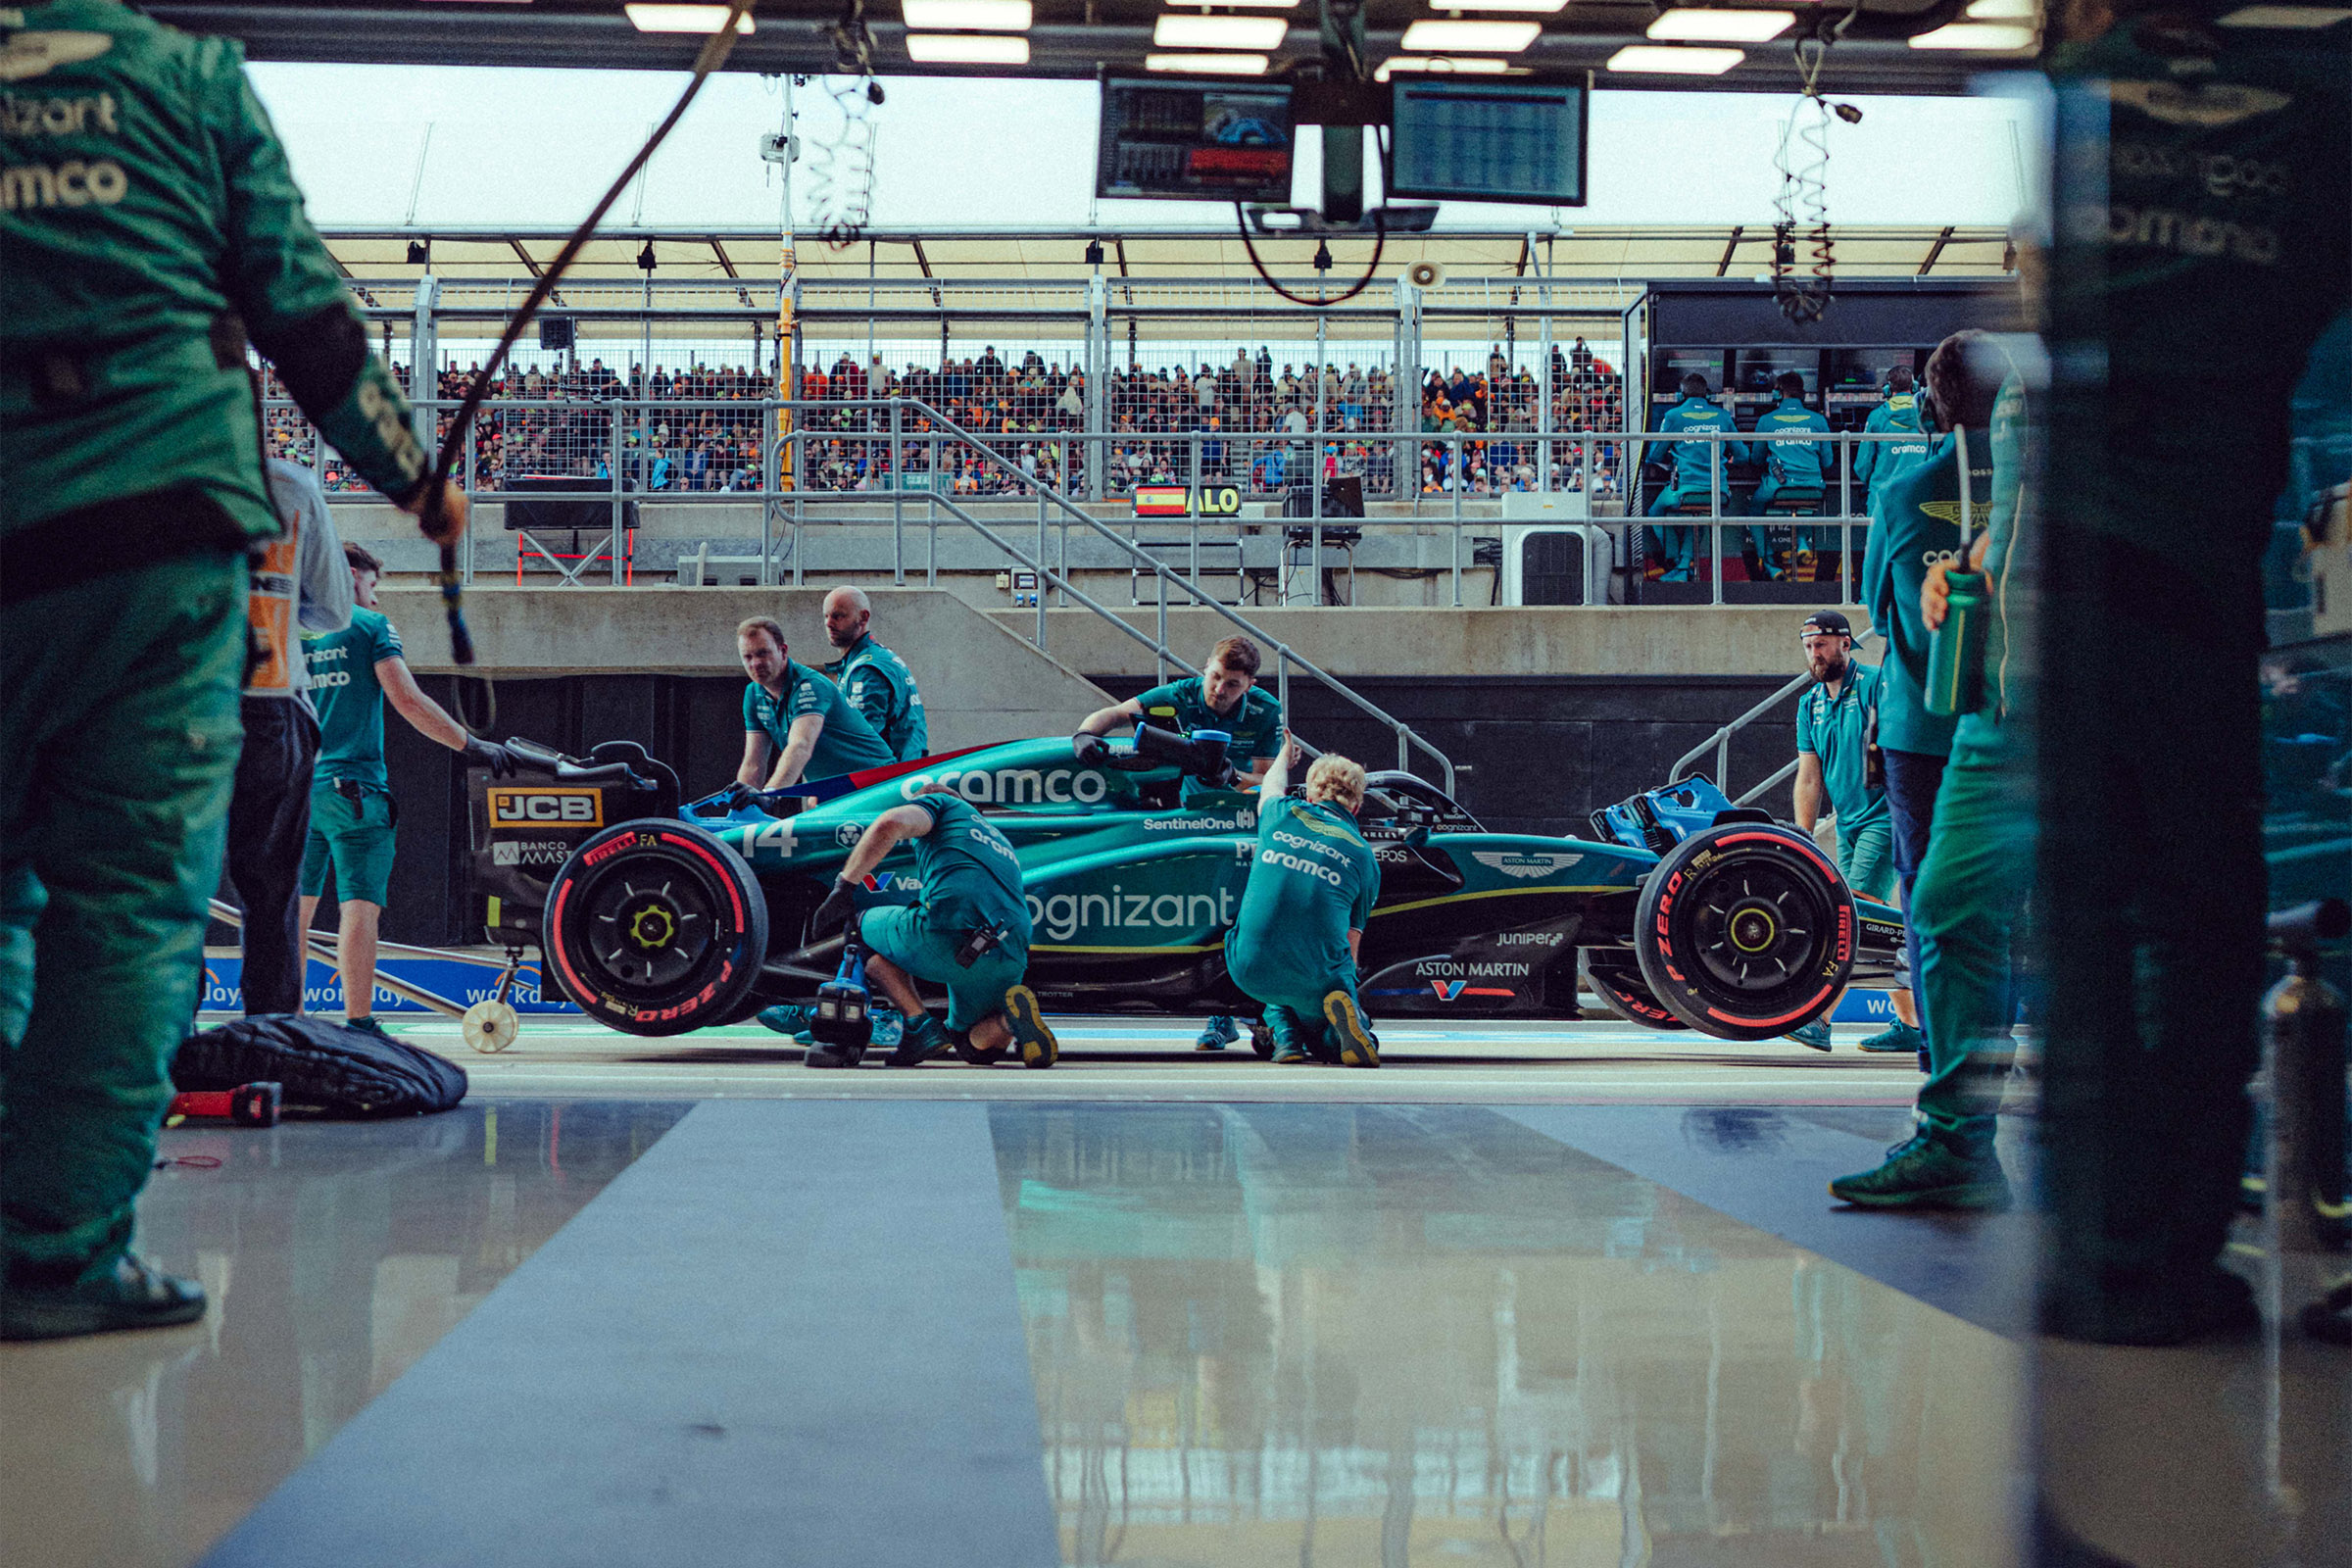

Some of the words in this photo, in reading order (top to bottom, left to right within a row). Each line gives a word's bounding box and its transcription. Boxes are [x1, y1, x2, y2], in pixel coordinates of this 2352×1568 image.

[1891, 444, 1927, 454] aramco
[1185, 488, 1239, 513] ALO
[498, 796, 594, 820] JCB
[1143, 817, 1236, 831] SentinelOne
[1437, 823, 1478, 832] cognizant
[520, 841, 567, 851] BANCO
[742, 818, 799, 858] 14
[1272, 830, 1352, 868] cognizant
[1261, 849, 1342, 886] aramco
[1026, 884, 1234, 941] ognizant
[1657, 871, 1683, 957] ZERO
[1415, 962, 1464, 976] ASTON
[1468, 963, 1530, 977] MARTIN
[635, 981, 716, 1022] ZERO
